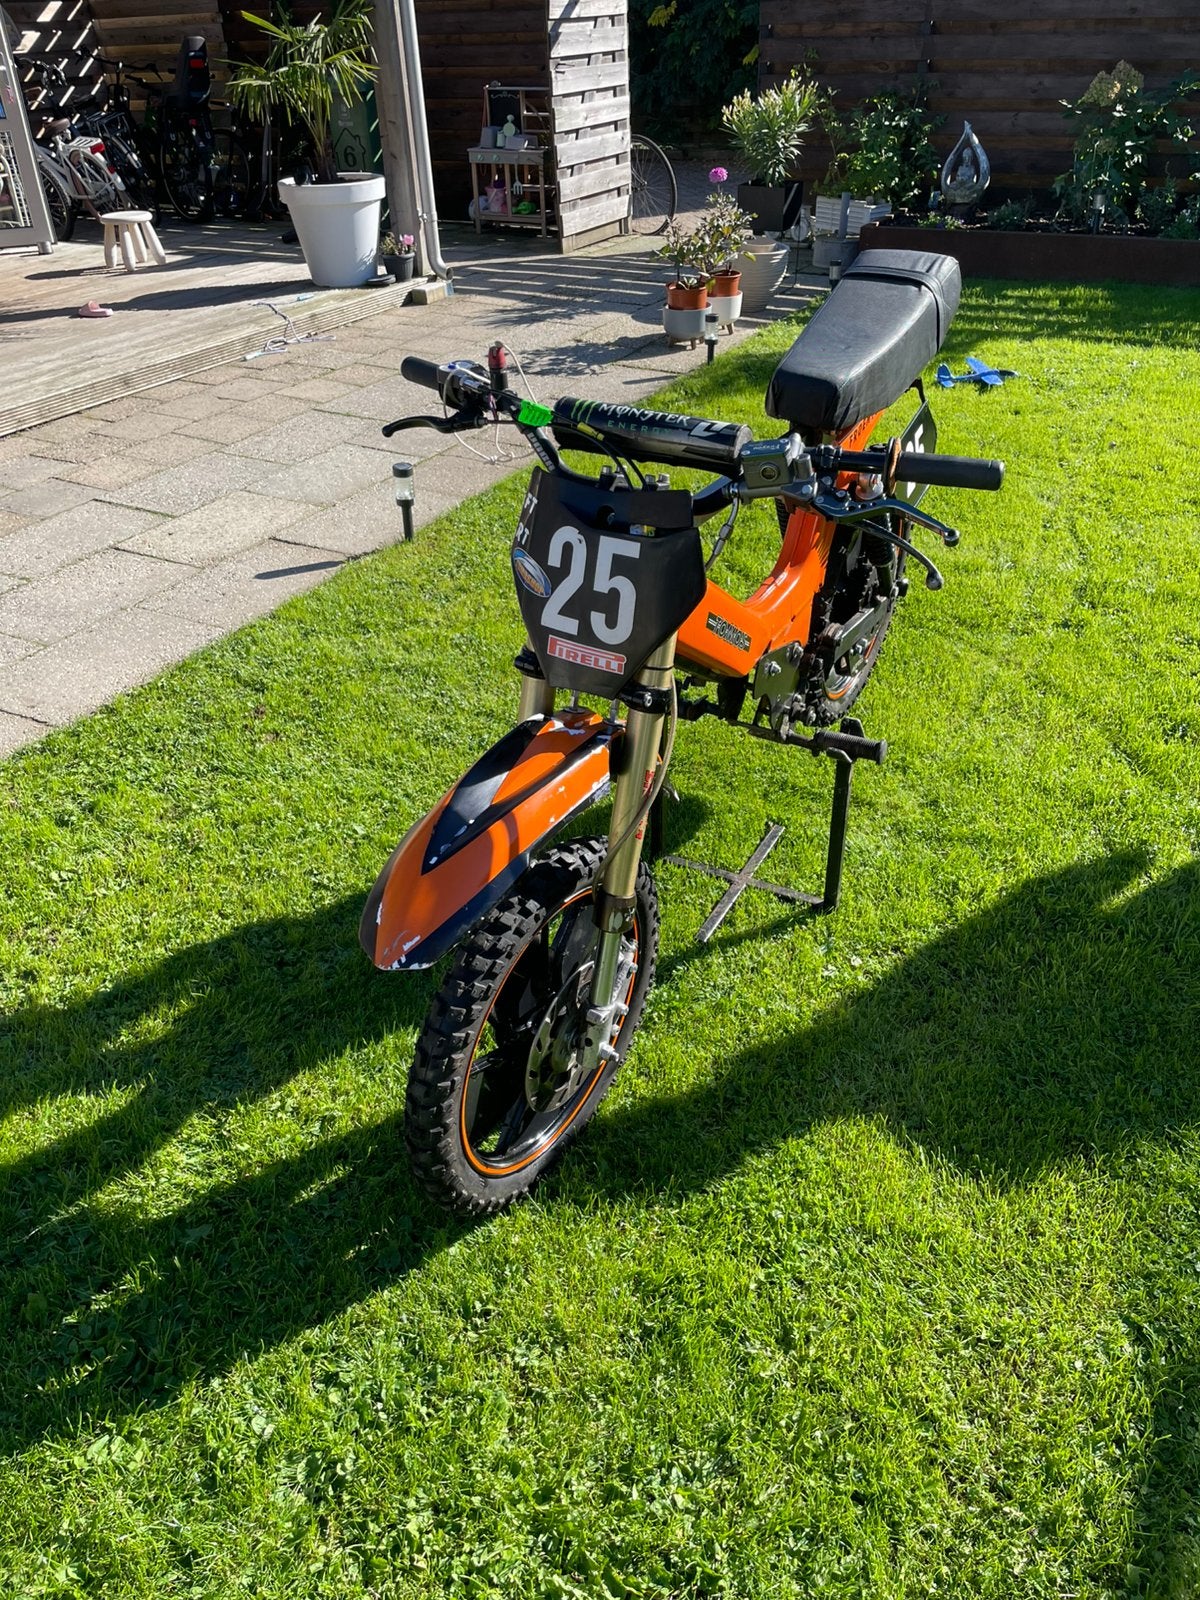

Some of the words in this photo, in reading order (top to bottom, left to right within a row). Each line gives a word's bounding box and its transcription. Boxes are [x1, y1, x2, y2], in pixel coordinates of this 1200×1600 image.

[343, 145, 357, 168] 6
[541, 525, 641, 645] 25
[547, 635, 626, 674] PIRELLI
